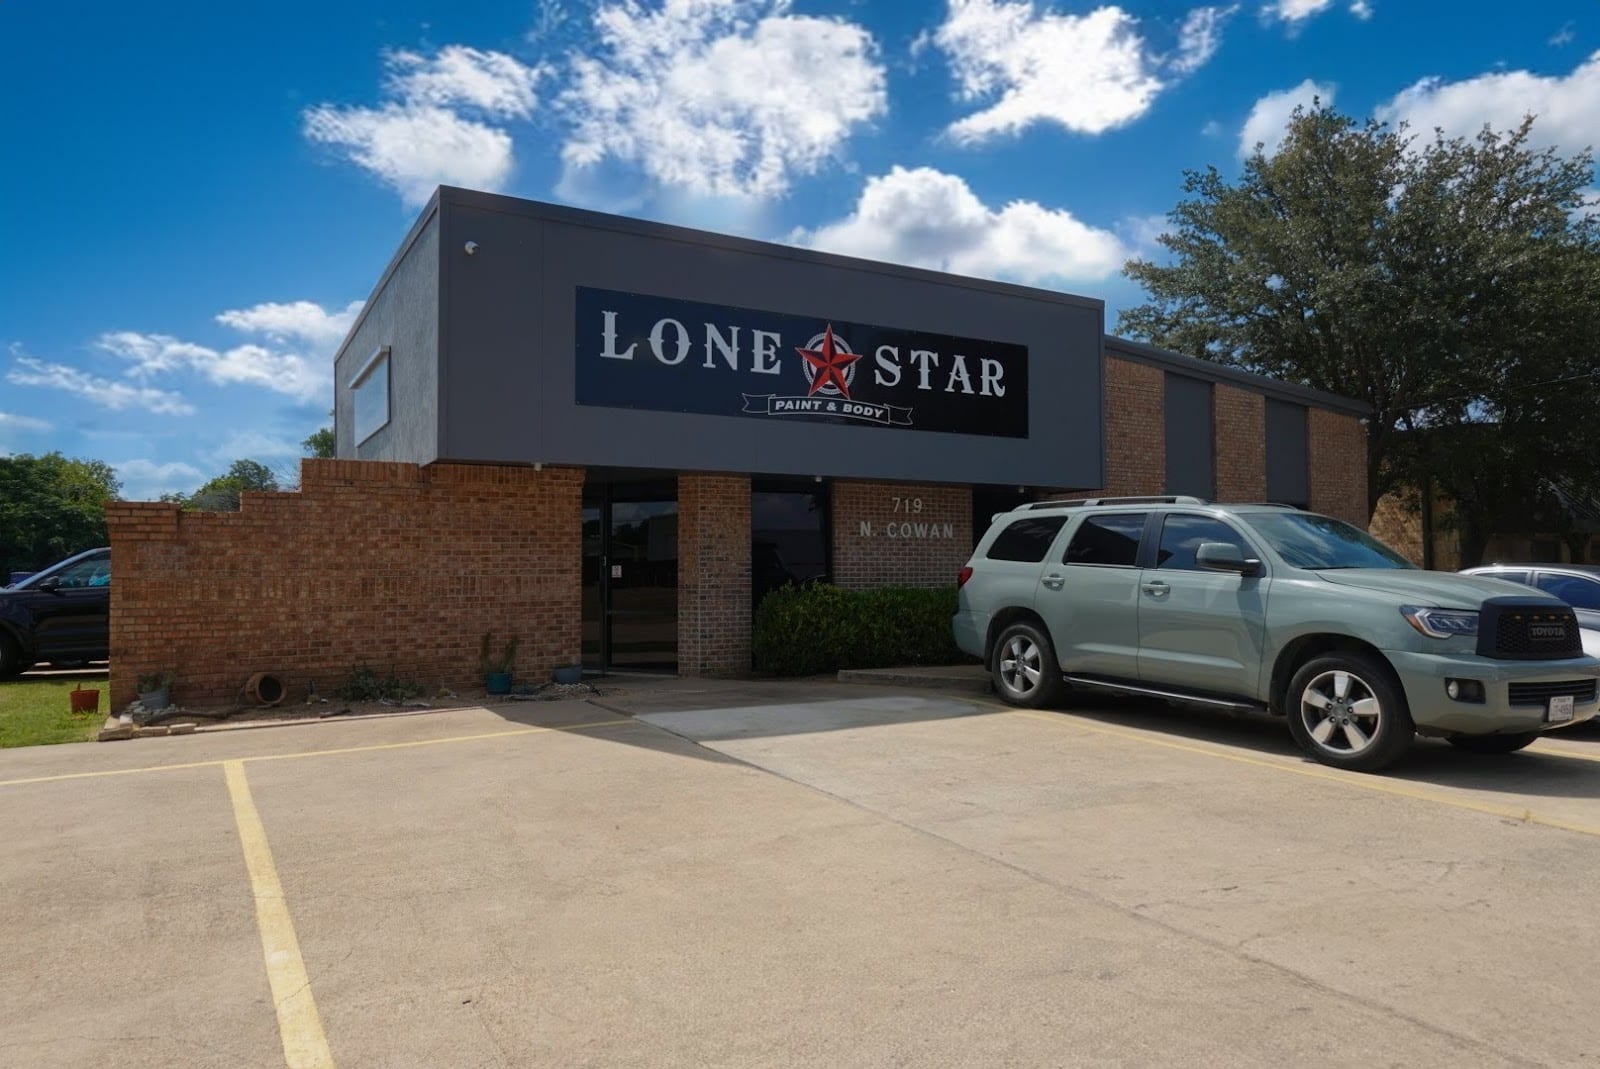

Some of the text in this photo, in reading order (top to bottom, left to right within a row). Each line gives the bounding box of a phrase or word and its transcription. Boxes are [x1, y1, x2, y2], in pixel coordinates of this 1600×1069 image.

[600, 311, 1007, 398] LONE STAR
[775, 400, 884, 418] PAINT & BODY
[892, 497, 922, 513] 719
[860, 521, 953, 538] N. COWAN
[1531, 627, 1565, 637] TOYOTA
